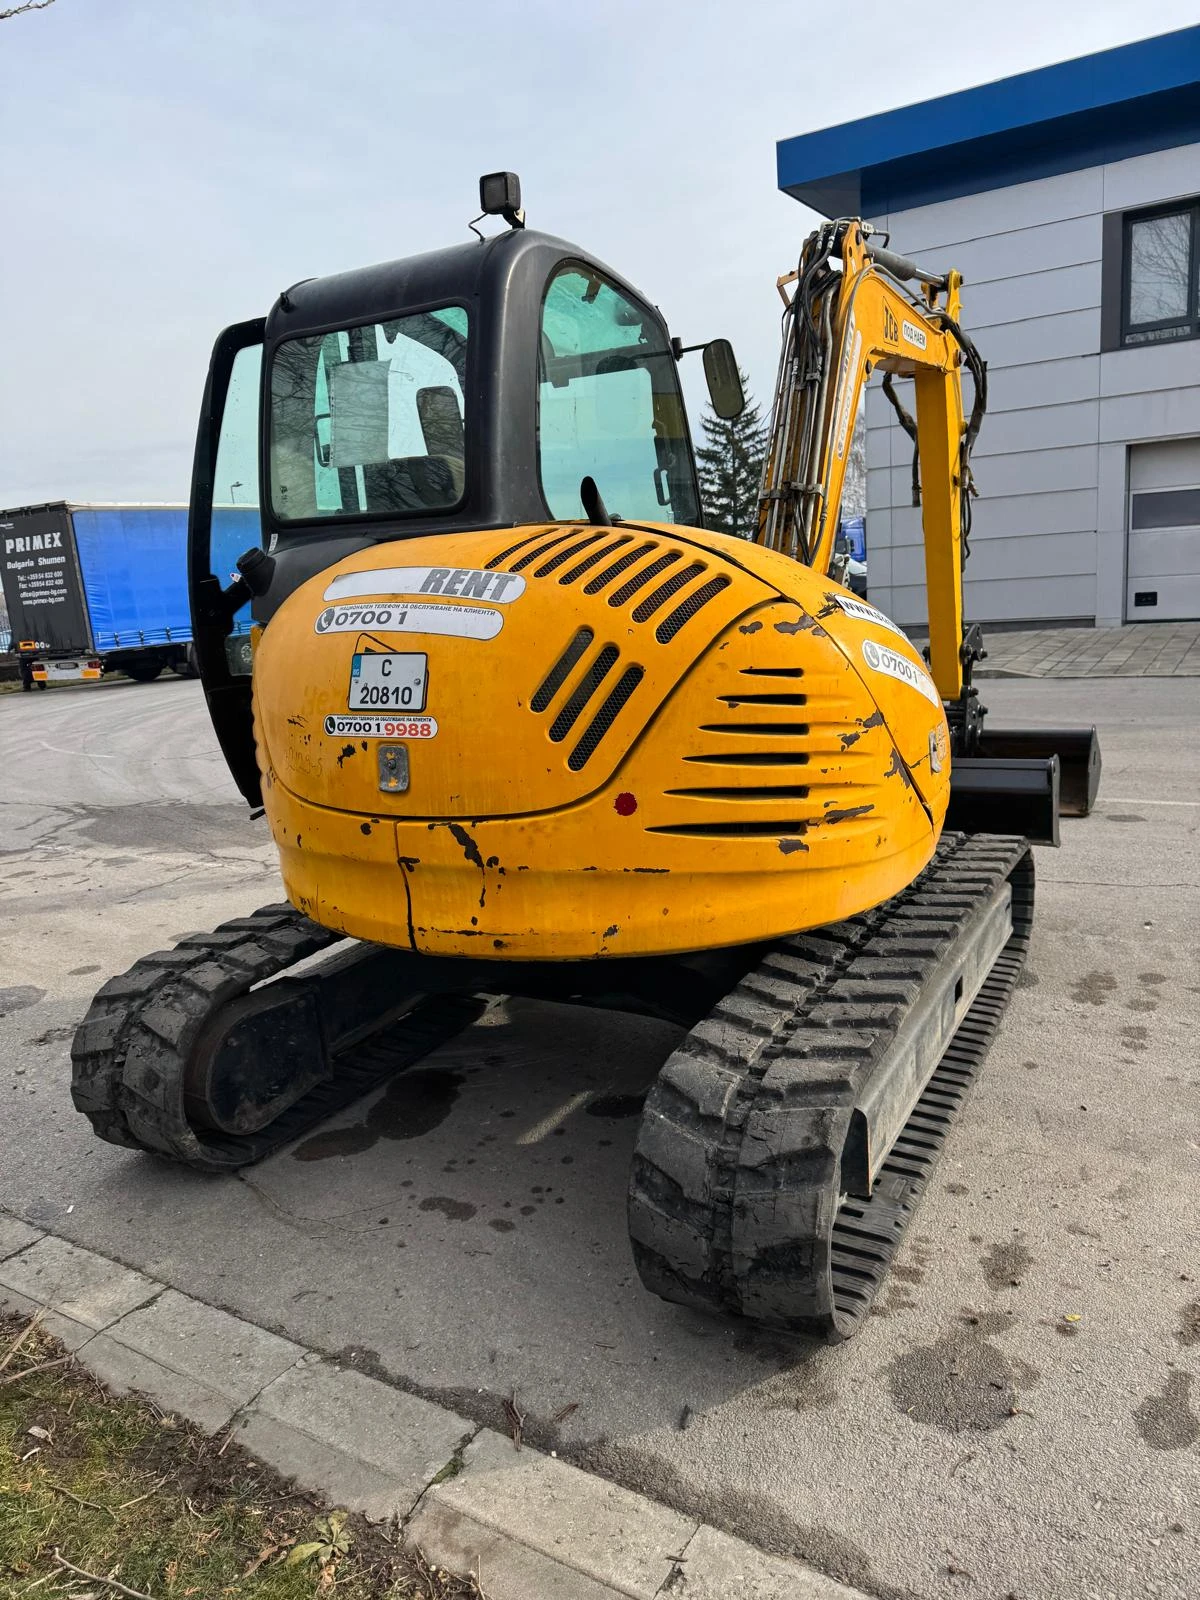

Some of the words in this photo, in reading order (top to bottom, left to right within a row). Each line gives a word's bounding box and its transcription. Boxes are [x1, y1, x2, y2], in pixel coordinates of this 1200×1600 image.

[885, 305, 898, 342] JCB
[904, 324, 914, 342] ПОД
[914, 331, 926, 347] НАЕМ
[5, 532, 63, 554] PRIMEX
[7, 558, 34, 570] Bulgaria
[38, 556, 66, 566] Shumen
[418, 569, 517, 601] RENT
[334, 610, 392, 626] 0700
[398, 611, 407, 625] 1
[409, 604, 452, 612] ОБСЛУЖВАНЕ
[463, 607, 496, 616] КЛИЕНТИ
[352, 668, 360, 676] BG
[381, 658, 392, 677] C
[881, 653, 912, 679] 0700
[913, 670, 918, 684] 1
[359, 686, 413, 705] 20810
[337, 722, 372, 732] 0700
[375, 722, 381, 732] 1
[384, 723, 432, 736] 9988
